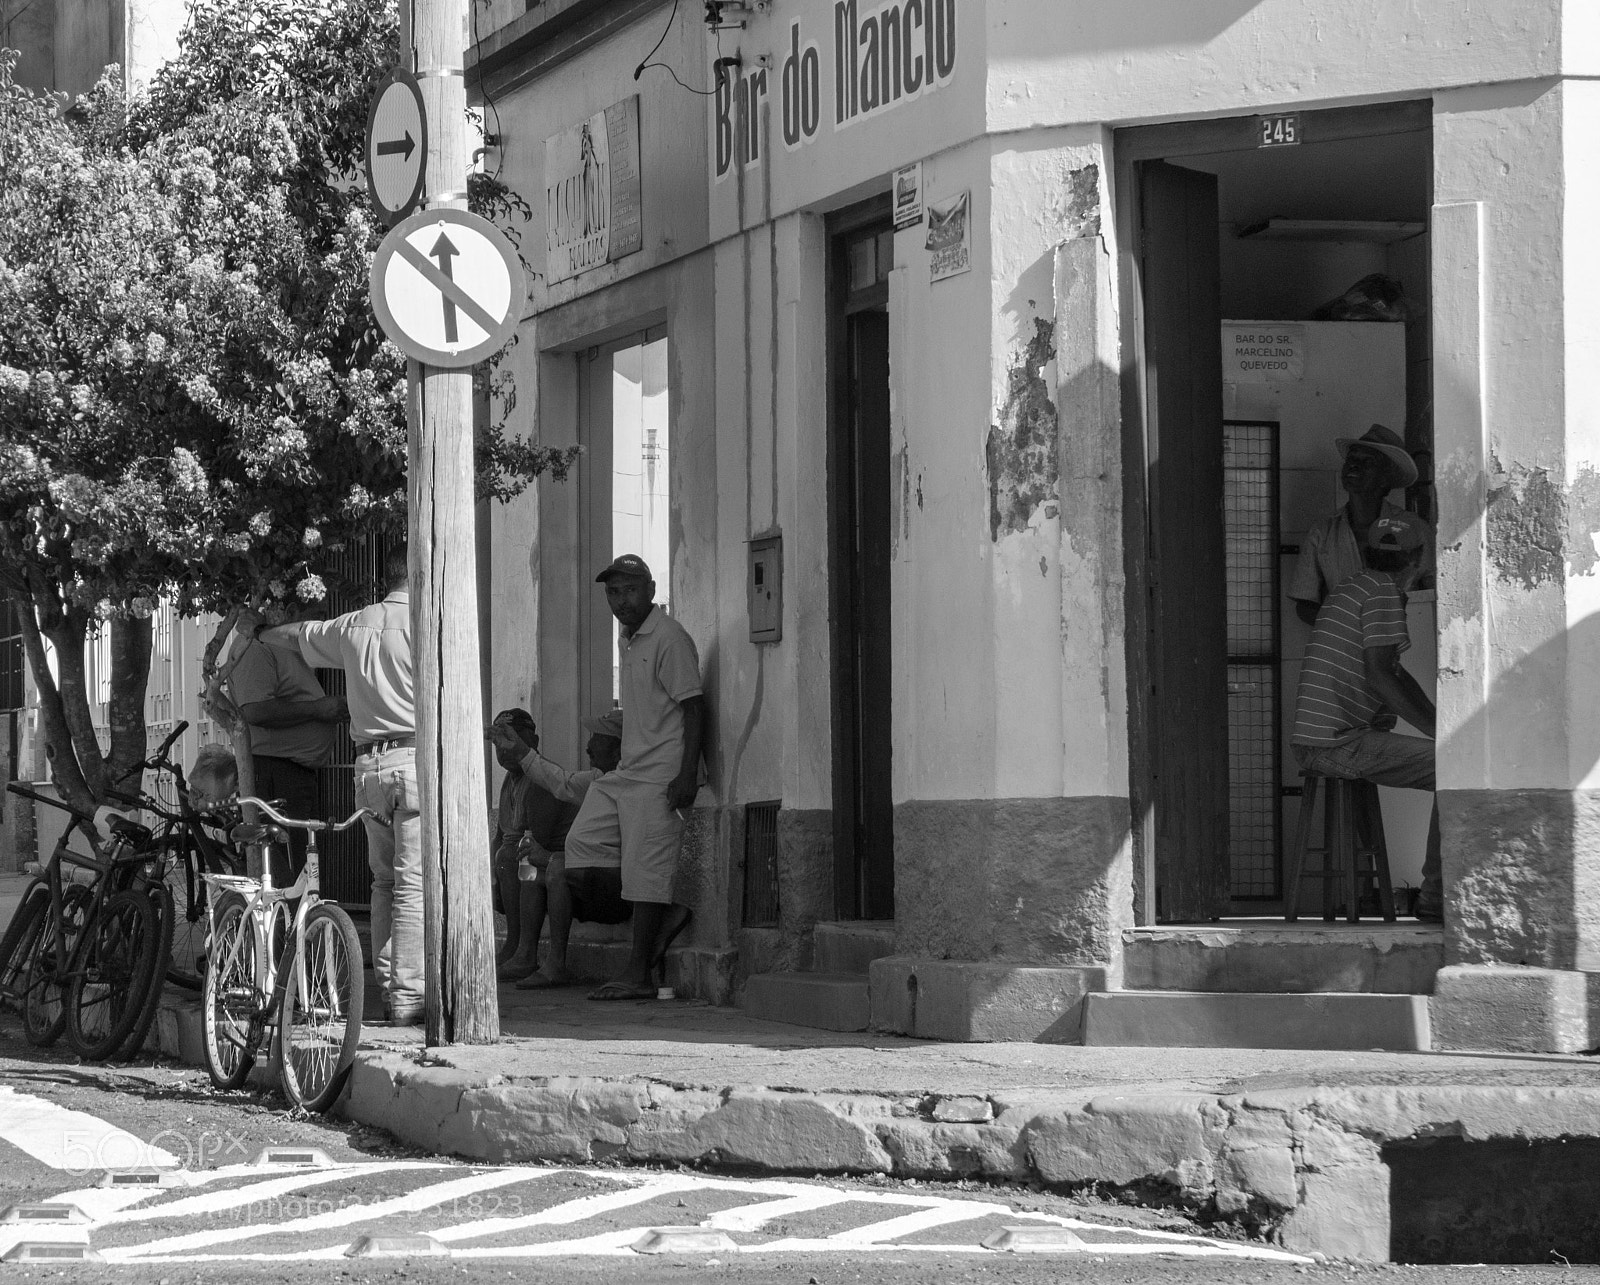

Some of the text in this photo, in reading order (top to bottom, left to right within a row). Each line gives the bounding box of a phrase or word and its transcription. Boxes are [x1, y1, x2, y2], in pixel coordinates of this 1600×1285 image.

[714, 62, 767, 177] Bar
[782, 23, 819, 146] do
[1262, 118, 1295, 144] 245
[1235, 334, 1256, 344] BAR
[1258, 335, 1273, 344] DO
[1235, 347, 1293, 357] MARCELINO
[1240, 360, 1288, 371] QUEVEDO
